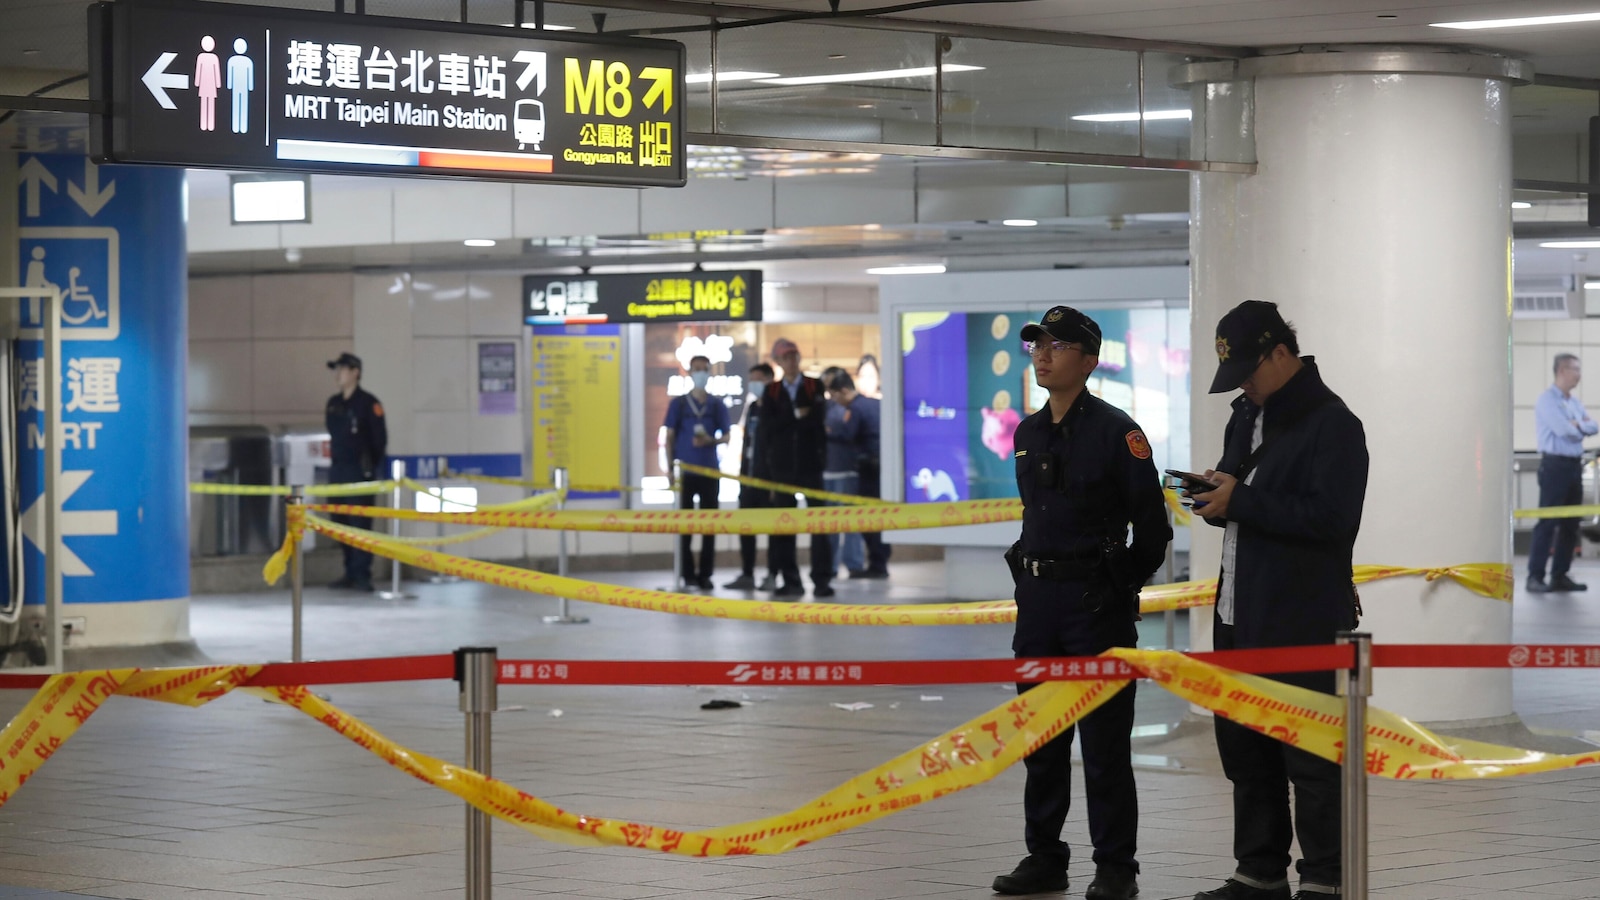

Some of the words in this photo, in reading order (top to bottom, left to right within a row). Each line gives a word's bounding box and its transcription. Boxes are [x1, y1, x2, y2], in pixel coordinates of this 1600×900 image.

[287, 40, 506, 99] 捷運台北車站
[564, 57, 632, 118] M8
[285, 94, 331, 120] MRT
[334, 97, 389, 127] Taipei
[394, 101, 439, 127] Main
[443, 105, 507, 131] Station
[579, 122, 633, 148] 公園路
[563, 148, 615, 165] Gongyuan
[616, 151, 634, 165] Rd.
[656, 155, 671, 166] EXIT
[694, 280, 728, 311] M8
[761, 665, 862, 681] 台北捷運公司
